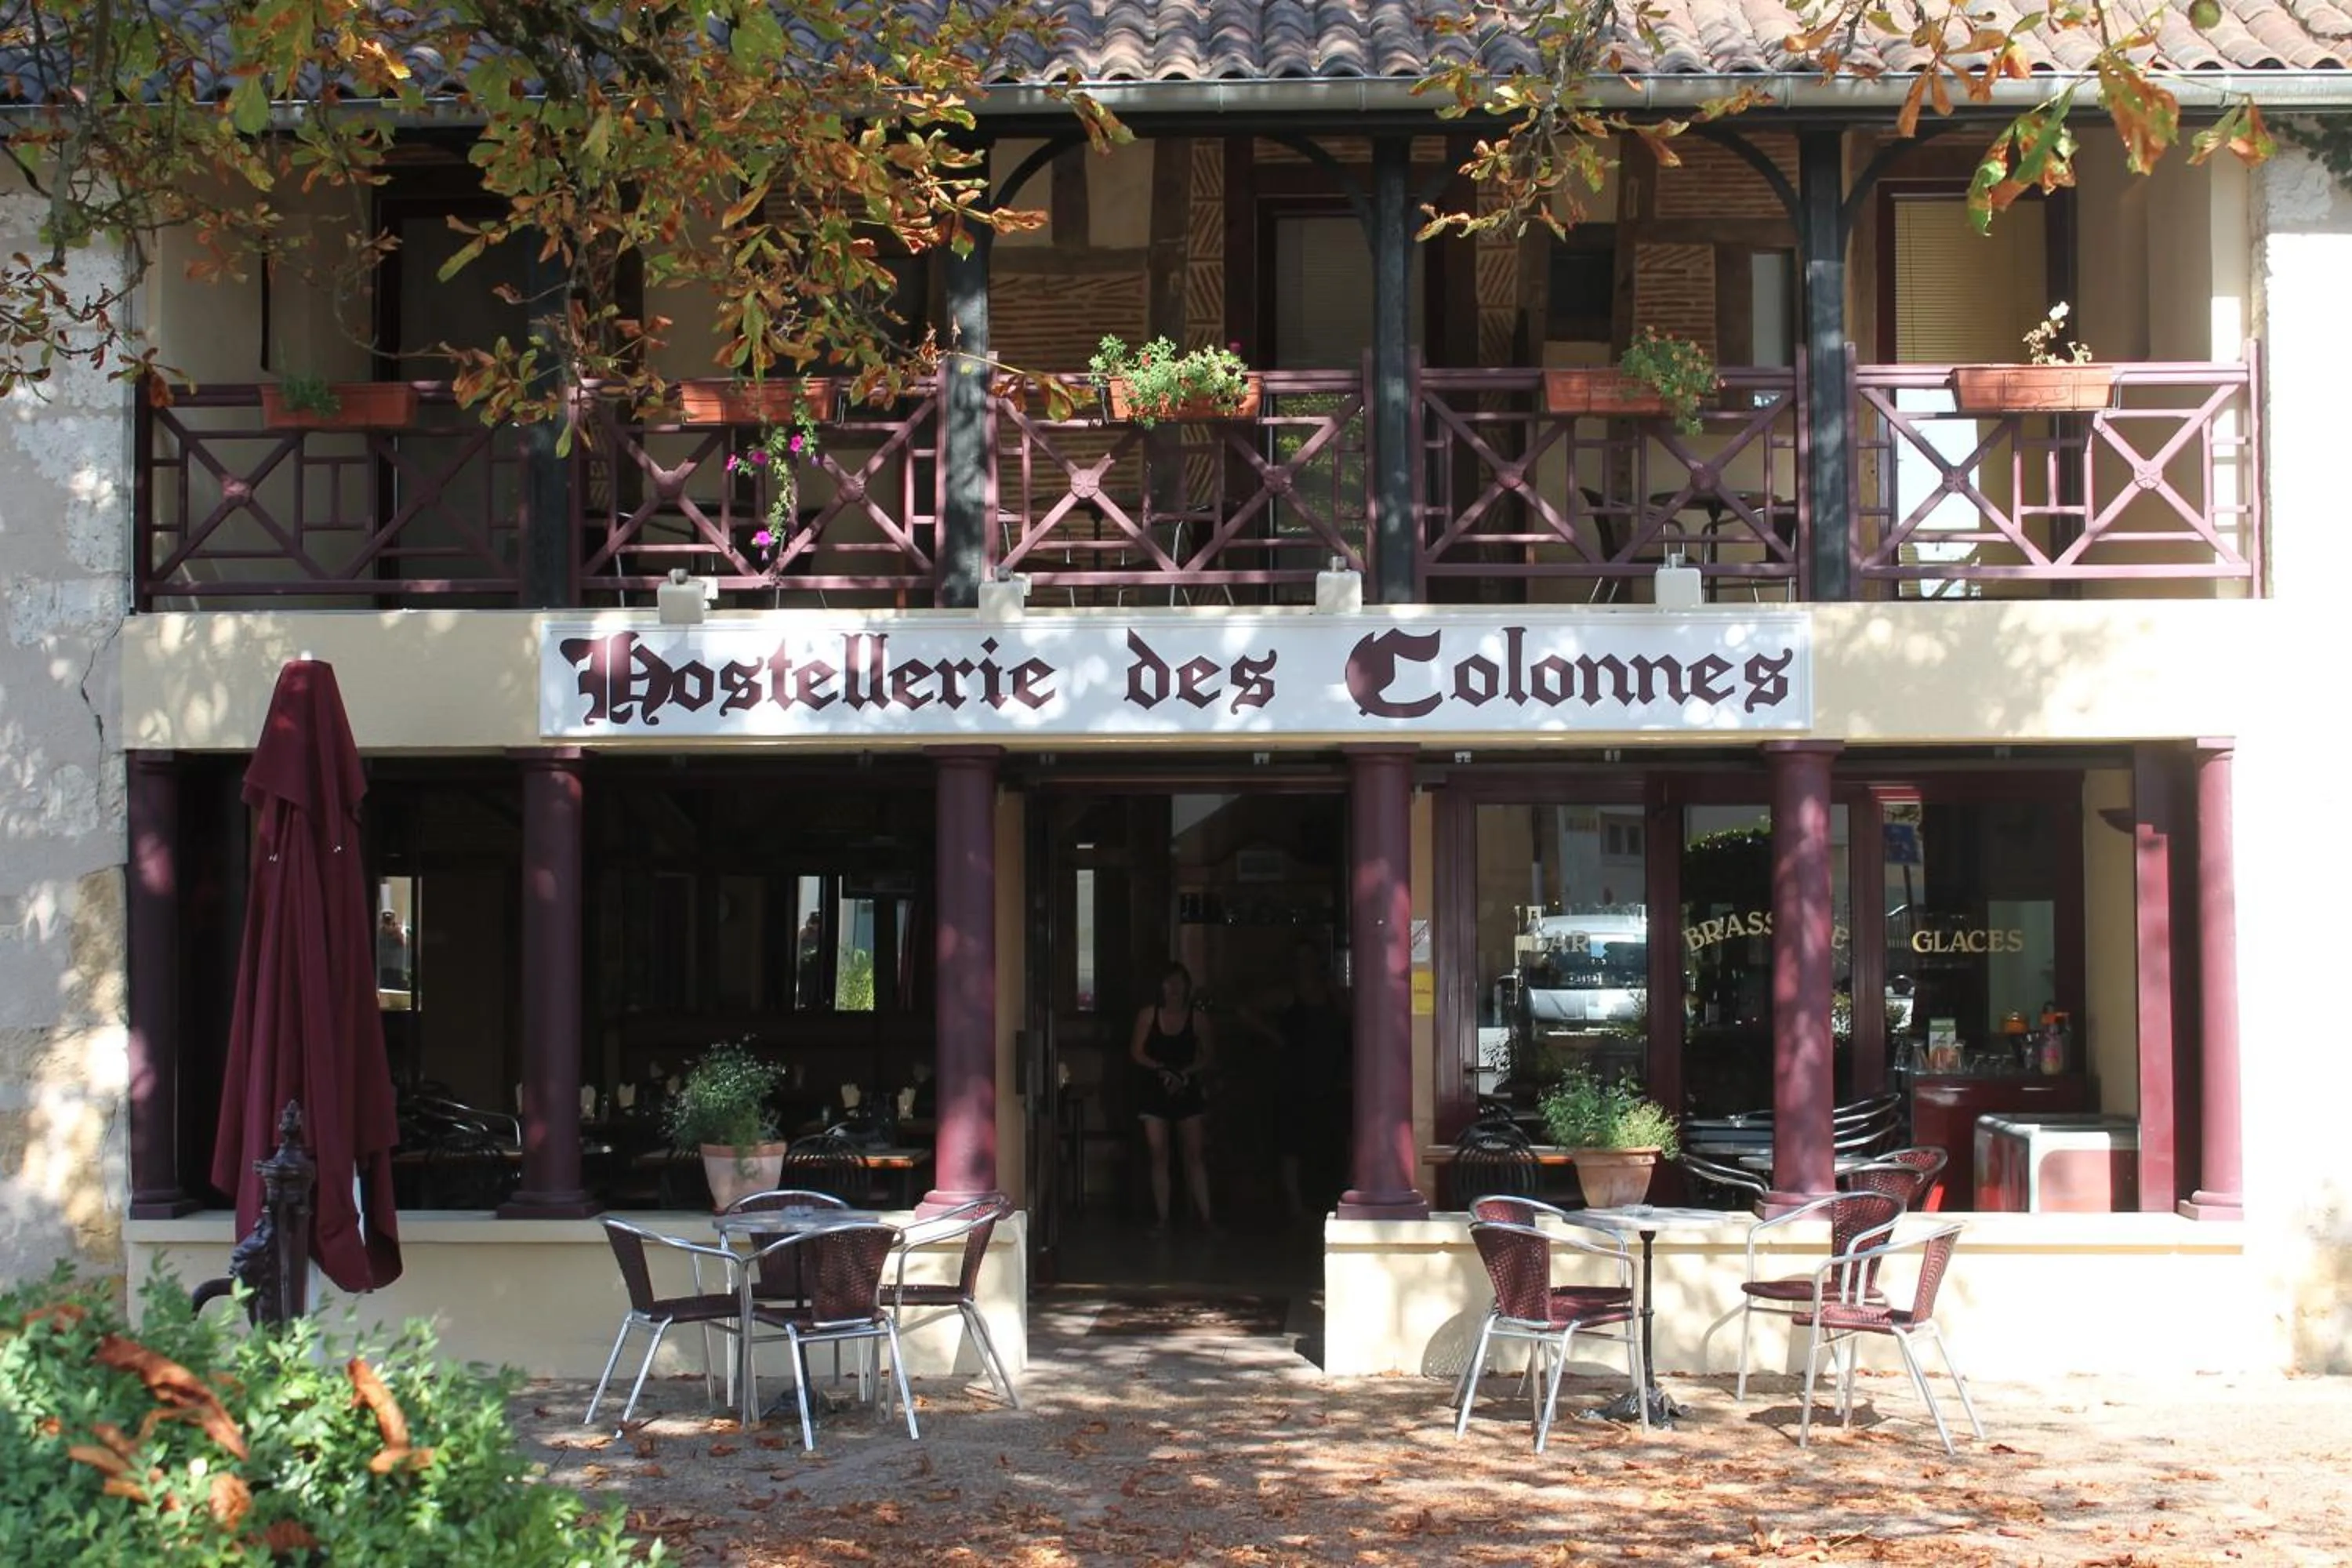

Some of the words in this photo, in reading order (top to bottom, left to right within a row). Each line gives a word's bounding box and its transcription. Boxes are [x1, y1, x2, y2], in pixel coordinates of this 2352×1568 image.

[559, 630, 1056, 726] Hostellerie
[1123, 626, 1278, 714] des
[1345, 626, 1794, 718] Colonnes
[1911, 930, 2023, 953] GLACES
